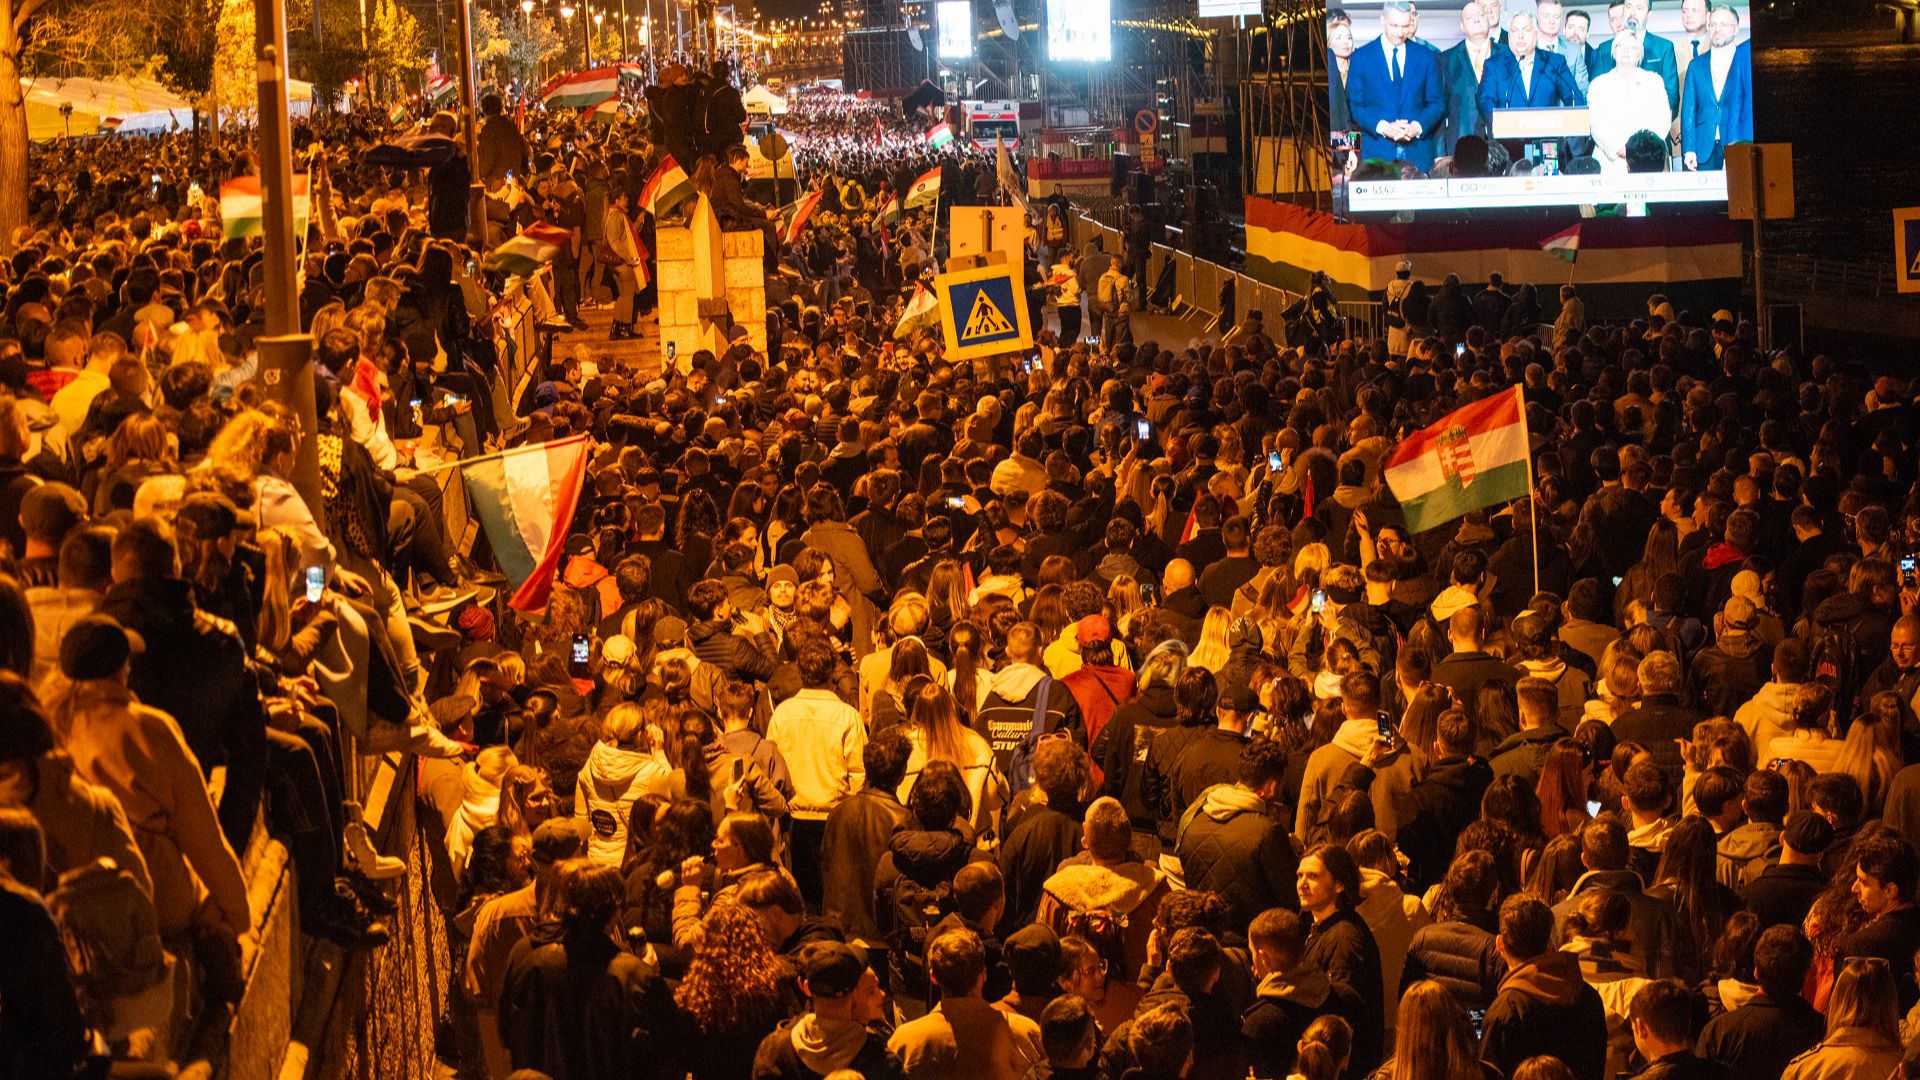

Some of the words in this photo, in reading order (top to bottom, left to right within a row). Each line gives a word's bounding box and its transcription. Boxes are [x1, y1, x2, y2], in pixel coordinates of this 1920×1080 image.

[987, 719, 1034, 732] Communit
[991, 727, 1030, 739] Culture
[992, 740, 1021, 751] STU
